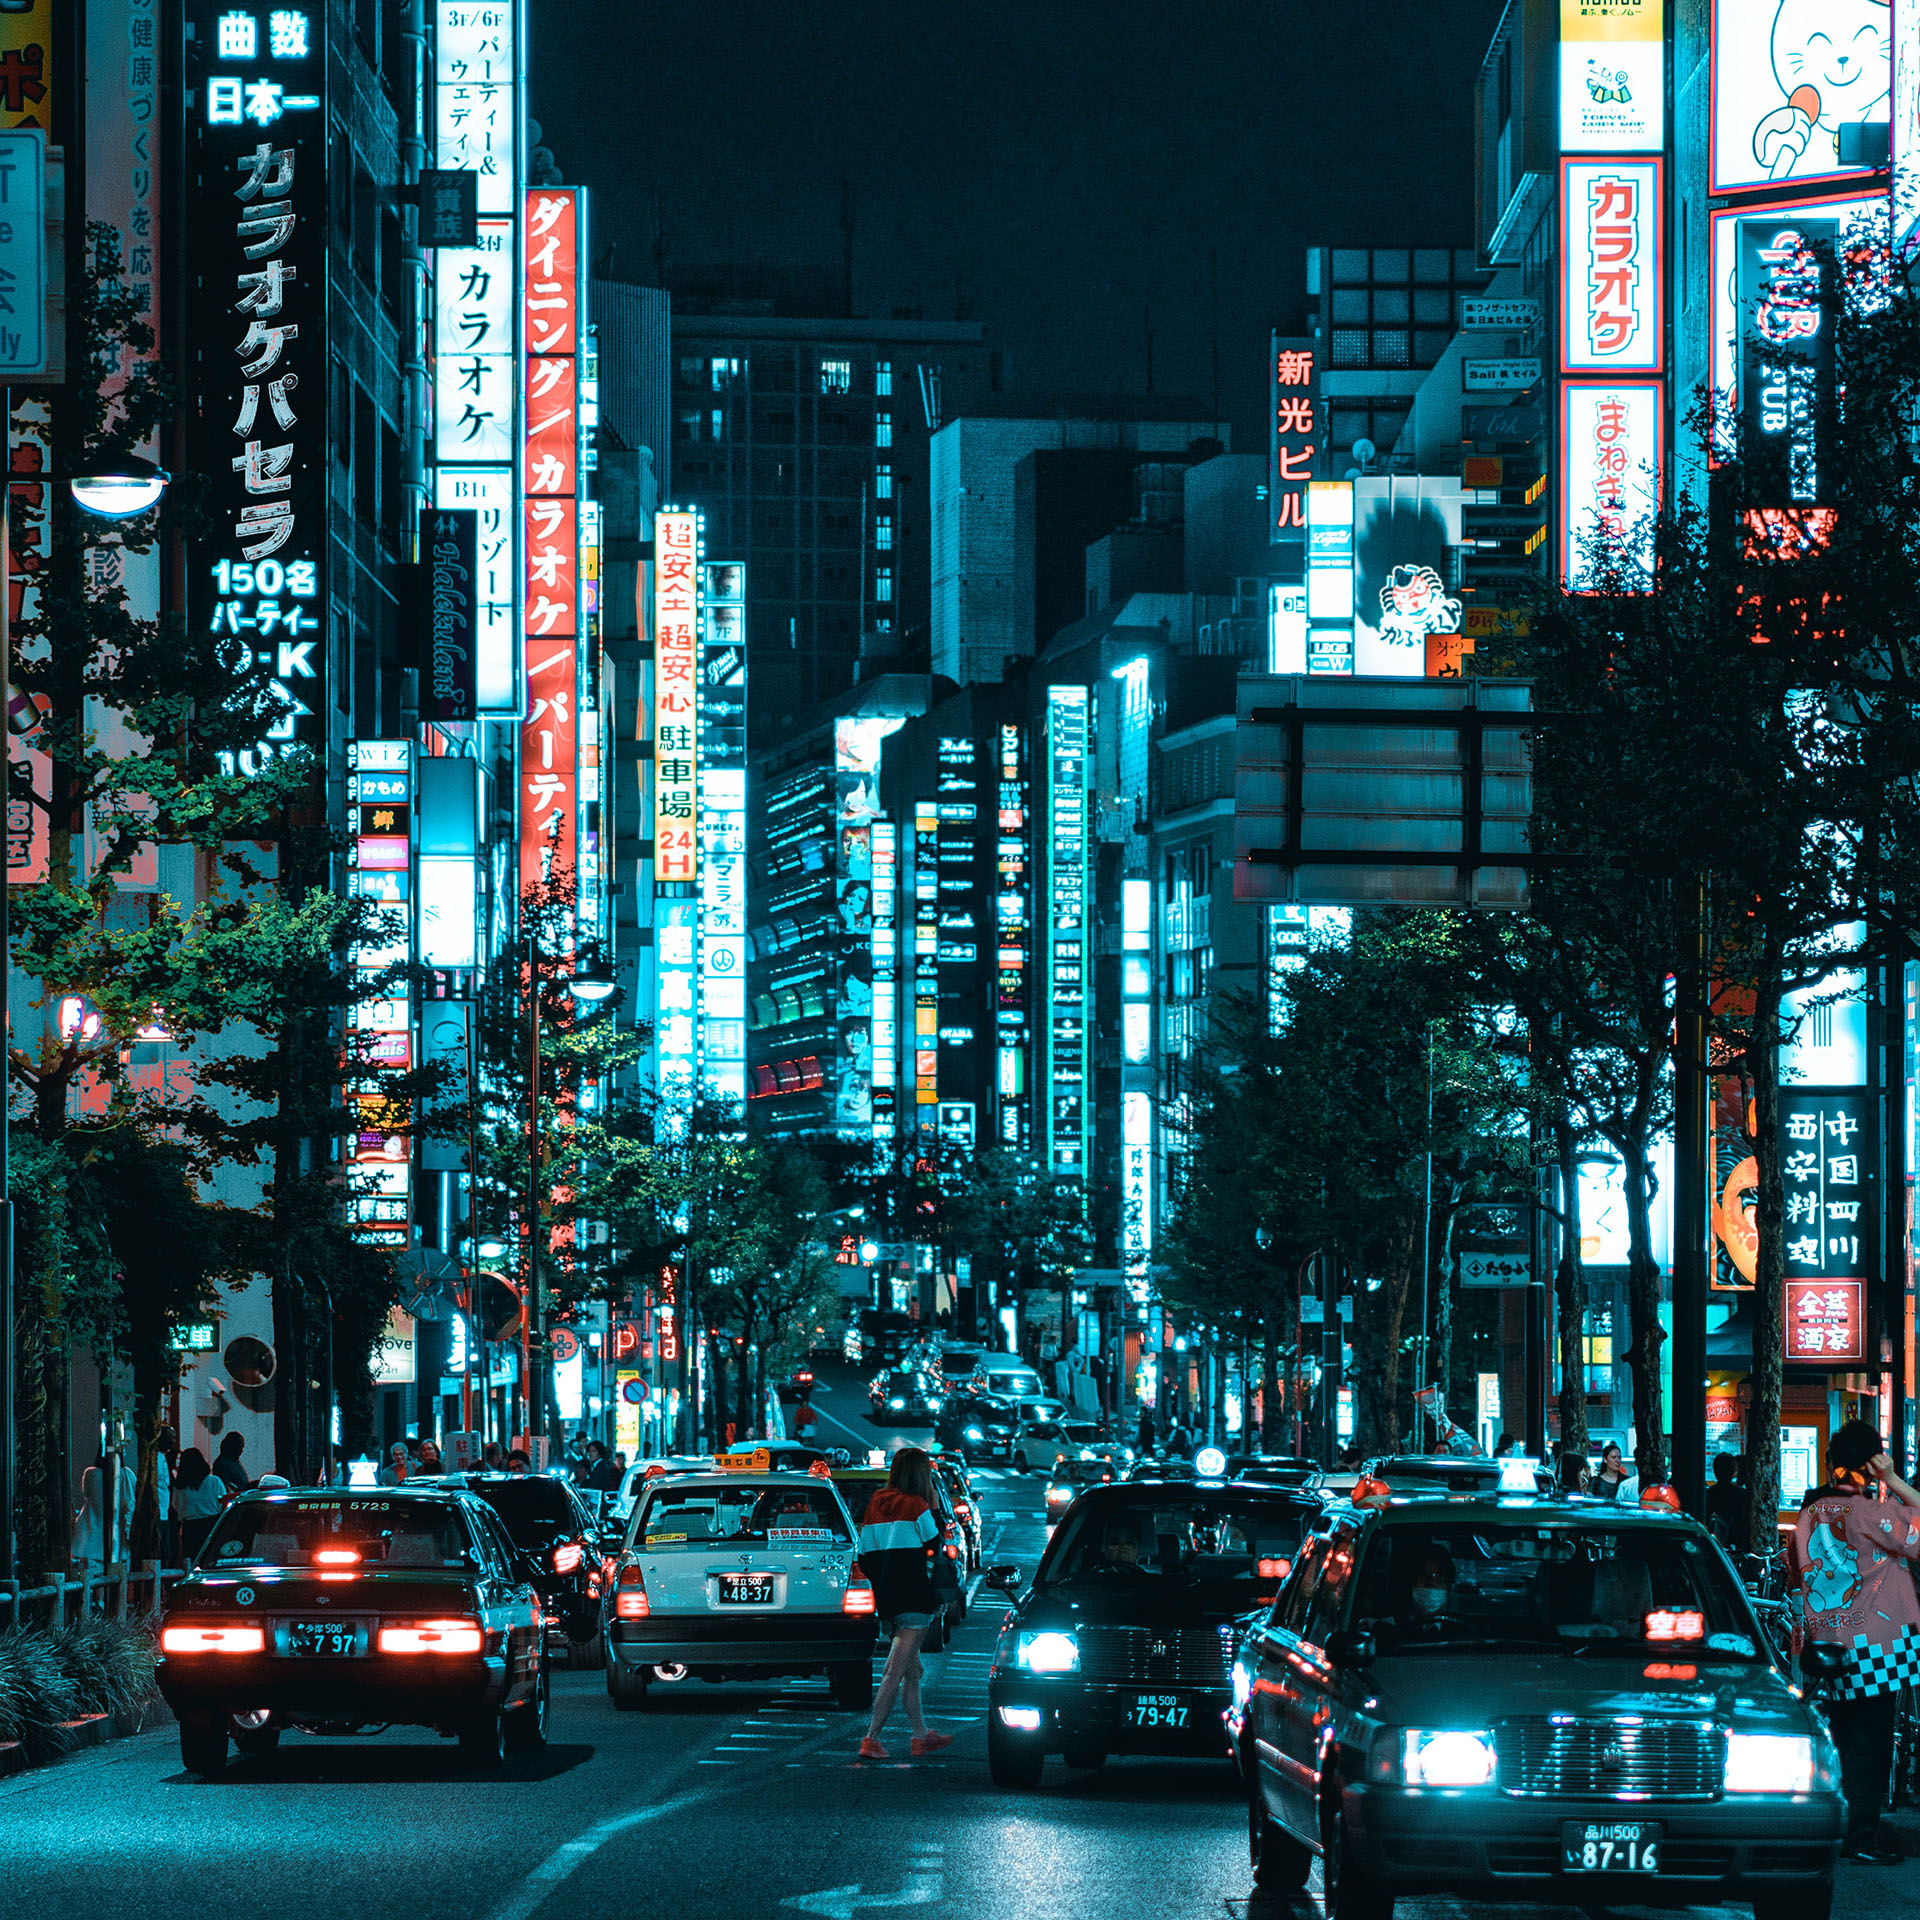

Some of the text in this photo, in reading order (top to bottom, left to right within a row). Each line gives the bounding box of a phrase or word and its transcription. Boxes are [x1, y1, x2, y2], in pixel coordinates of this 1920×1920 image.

[217, 11, 310, 58] 曲数
[448, 10, 504, 27] 3F/6F
[207, 77, 319, 126] 日本一
[449, 59, 471, 171] ウェディン
[1591, 178, 1636, 352] カラオケ
[232, 142, 299, 561] カラオケパセラ
[457, 264, 493, 445] カラオケ
[1277, 349, 1315, 528] 新光ビル
[211, 558, 316, 597] 150名
[481, 508, 508, 627] リゾート
[661, 522, 692, 612] 超安全
[210, 600, 318, 636] パーティー
[433, 541, 469, 704] Halekulani
[660, 623, 693, 714] 超安心
[362, 781, 406, 795] かもめ
[658, 725, 693, 819] 駐車場
[375, 1201, 408, 1221] 極楽
[1784, 1111, 1820, 1266] 西安料理
[1825, 1110, 1862, 1266] 中国四川
[1797, 1324, 1850, 1352] 酒家
[350, 1501, 391, 1511] 5723
[819, 1554, 845, 1565] 492
[731, 1586, 772, 1601] 48-37
[1135, 1706, 1188, 1727] 79-47
[1582, 1841, 1657, 1870] 87-16
[1584, 1824, 1640, 1841] 品川500
